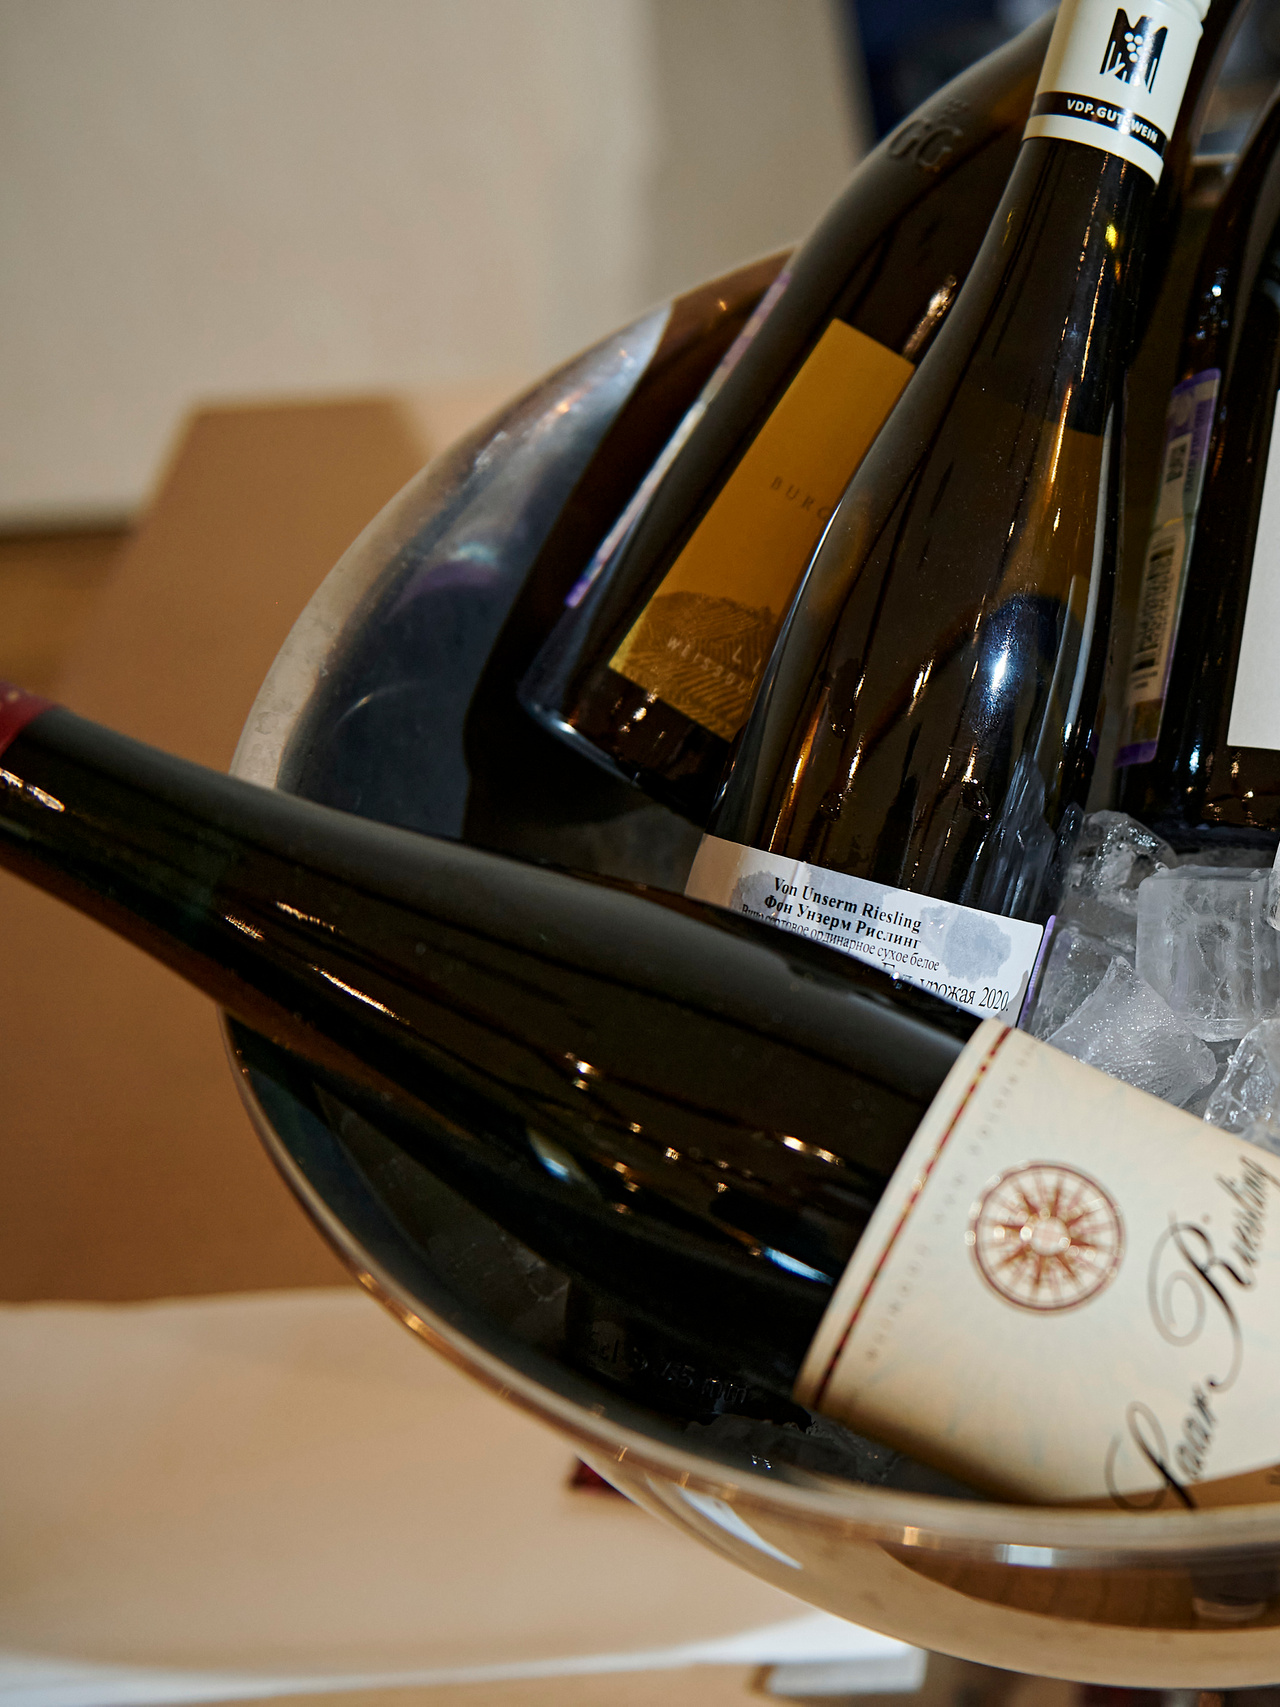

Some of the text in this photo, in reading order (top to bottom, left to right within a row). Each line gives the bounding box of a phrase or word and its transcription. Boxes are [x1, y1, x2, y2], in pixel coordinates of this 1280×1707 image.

[763, 894, 922, 950] Фон Унзерм Рислинг
[774, 876, 922, 934] Von Unserm Riesling
[876, 944, 909, 963] сухое
[909, 951, 941, 972] белое
[1103, 1383, 1217, 1513] Saar
